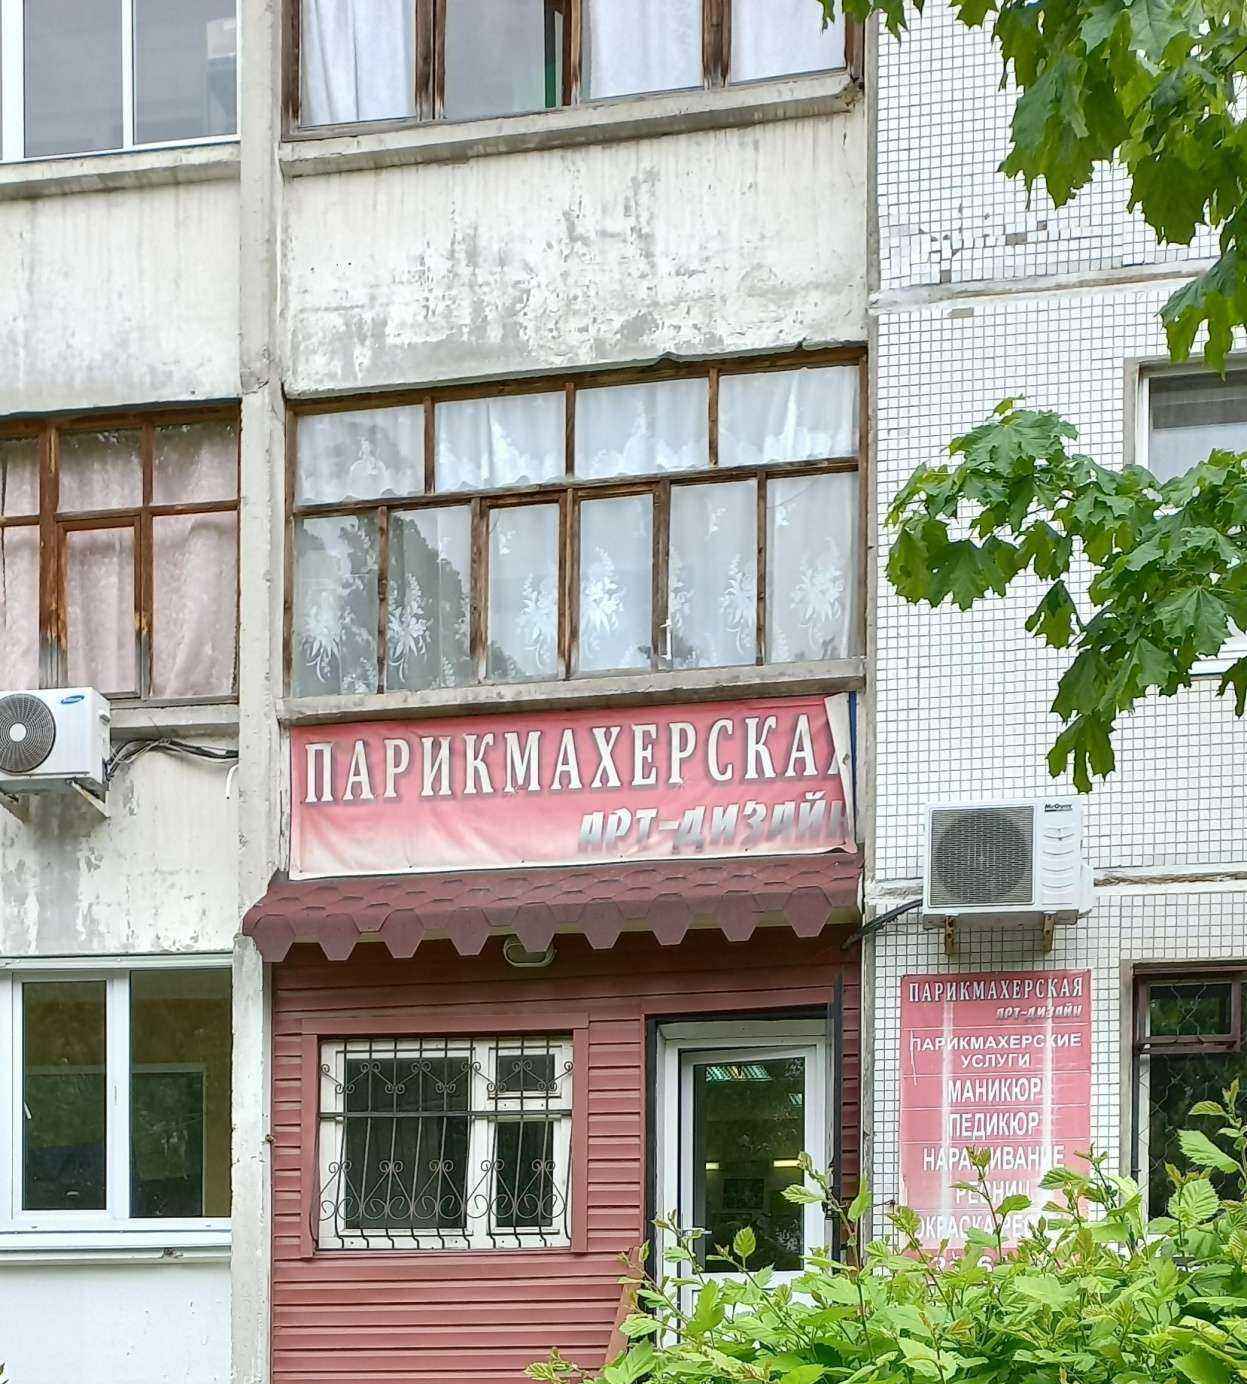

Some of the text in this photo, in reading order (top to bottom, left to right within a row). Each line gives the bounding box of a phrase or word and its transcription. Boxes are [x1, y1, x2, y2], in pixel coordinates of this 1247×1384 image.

[304, 713, 841, 803] ПАРИКМАХЕРСКА
[909, 977, 1082, 1002] ПАРИКМАХЕРСКАЯ
[911, 1033, 1081, 1050] ПАРИКМАХЕРСКИЕ
[961, 1053, 1030, 1068] УСЛУГИ
[948, 1077, 1042, 1102] МАНИКЮР
[949, 1111, 1040, 1139] ПЕДИКЮР
[923, 1144, 1065, 1173] НАРАИВАНИЕ
